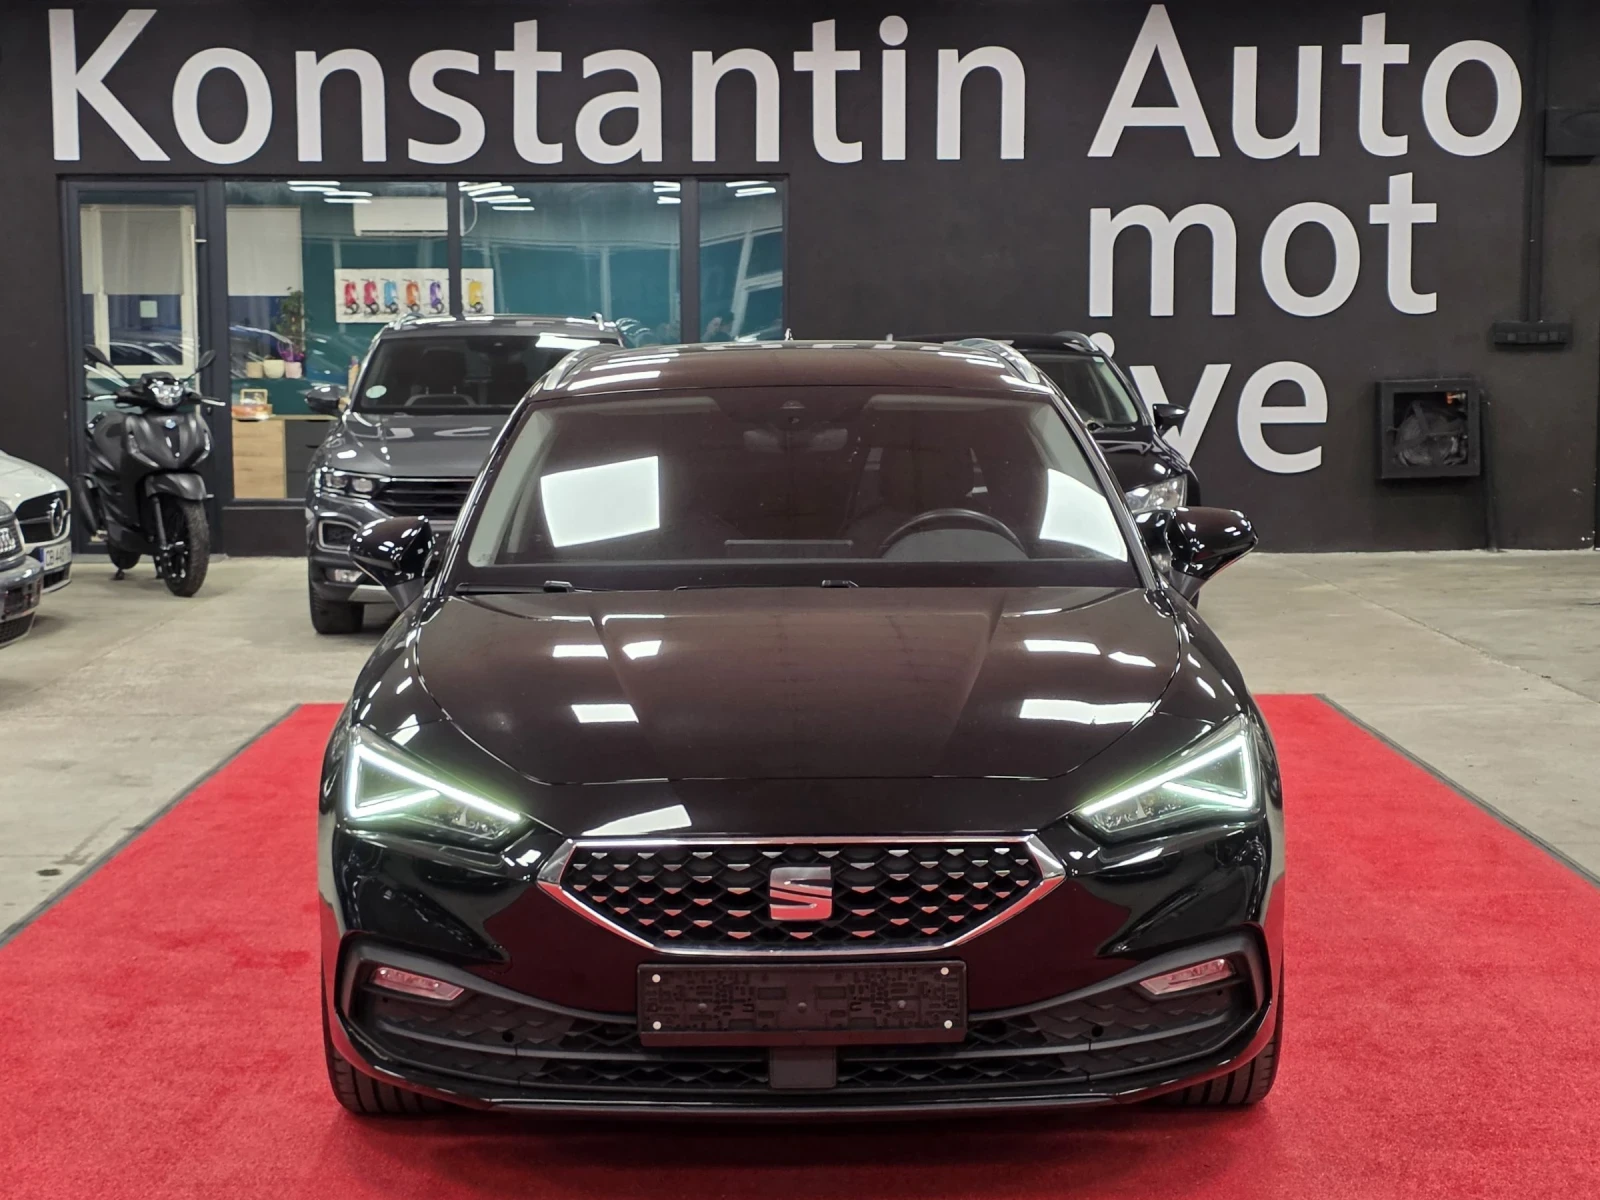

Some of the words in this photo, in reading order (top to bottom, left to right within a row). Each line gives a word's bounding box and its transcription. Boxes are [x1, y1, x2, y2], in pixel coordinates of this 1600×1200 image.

[49, 9, 1026, 165] Konstantin
[1087, 4, 1522, 159] Auto
[1088, 172, 1438, 318] mot
[1089, 332, 1329, 475] ve
